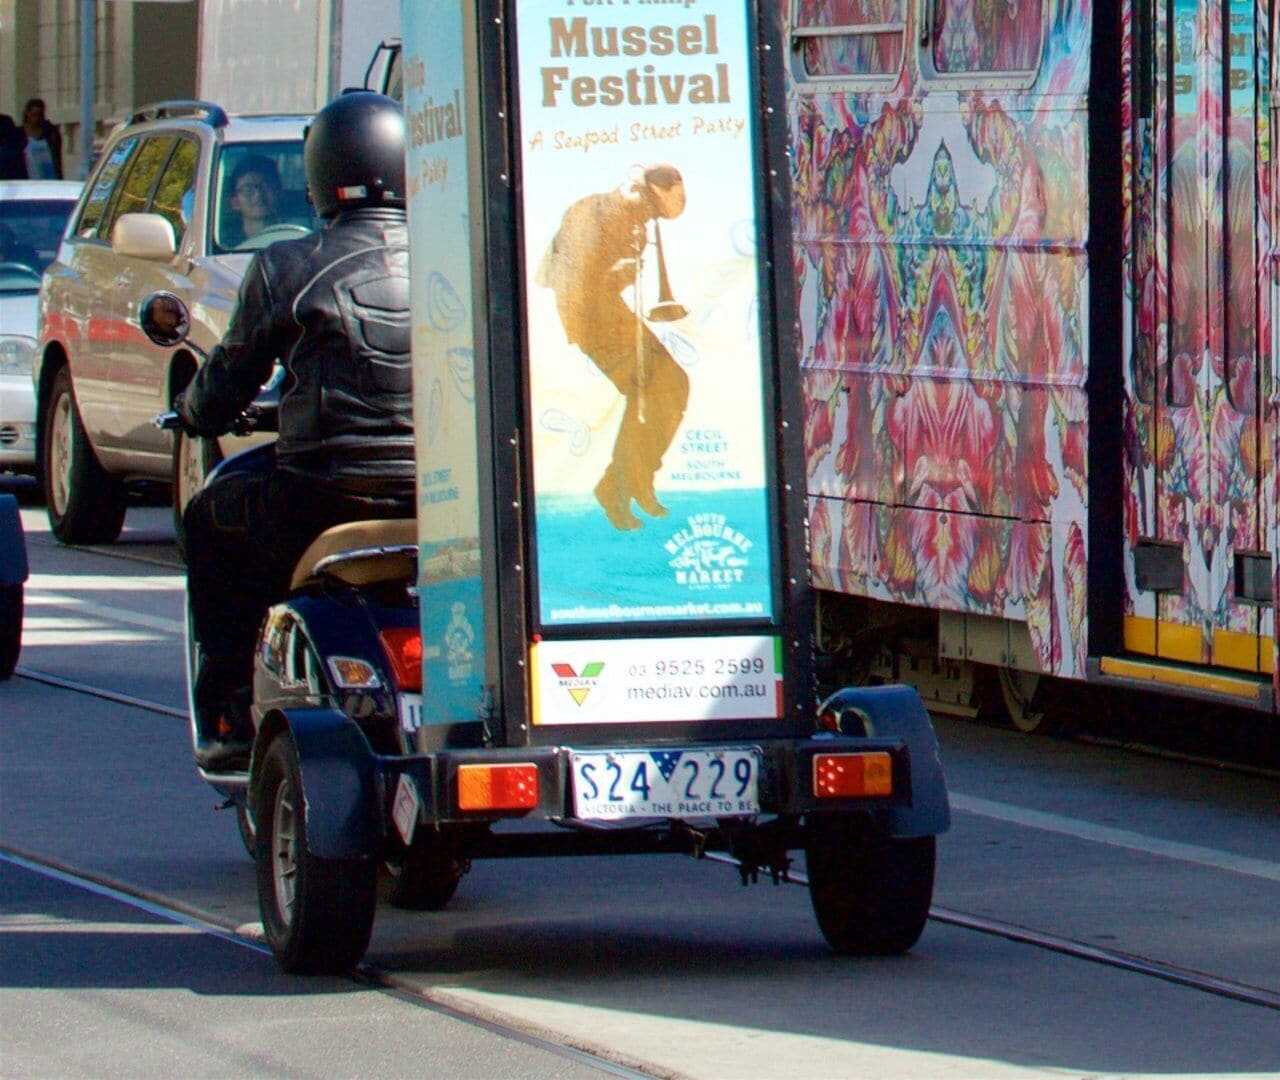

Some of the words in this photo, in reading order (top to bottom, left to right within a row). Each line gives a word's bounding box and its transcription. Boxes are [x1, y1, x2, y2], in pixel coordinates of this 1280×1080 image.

[549, 14, 719, 58] Mussel
[540, 63, 731, 108] Festival
[529, 131, 544, 151] A
[554, 128, 619, 152] Seafood
[630, 122, 682, 141] Street
[692, 115, 745, 143] Party
[686, 429, 723, 440] CECIL
[681, 442, 728, 453] STREET
[687, 461, 725, 470] SOUTH
[671, 471, 742, 481] MELBOURNE
[688, 513, 726, 528] SOUTH
[664, 524, 753, 555] MELBOURNE
[676, 569, 744, 585] MARKET
[628, 665, 647, 677] 03
[655, 660, 705, 677] 9525
[714, 657, 764, 675] 2599
[628, 682, 766, 700] mediav.com.au
[580, 761, 650, 802] S24
[683, 758, 751, 798] 229
[586, 803, 636, 814] VICTORIA
[652, 802, 672, 813] THE
[679, 801, 711, 813] PLACE
[718, 801, 732, 812] TO
[739, 800, 752, 811] BE
